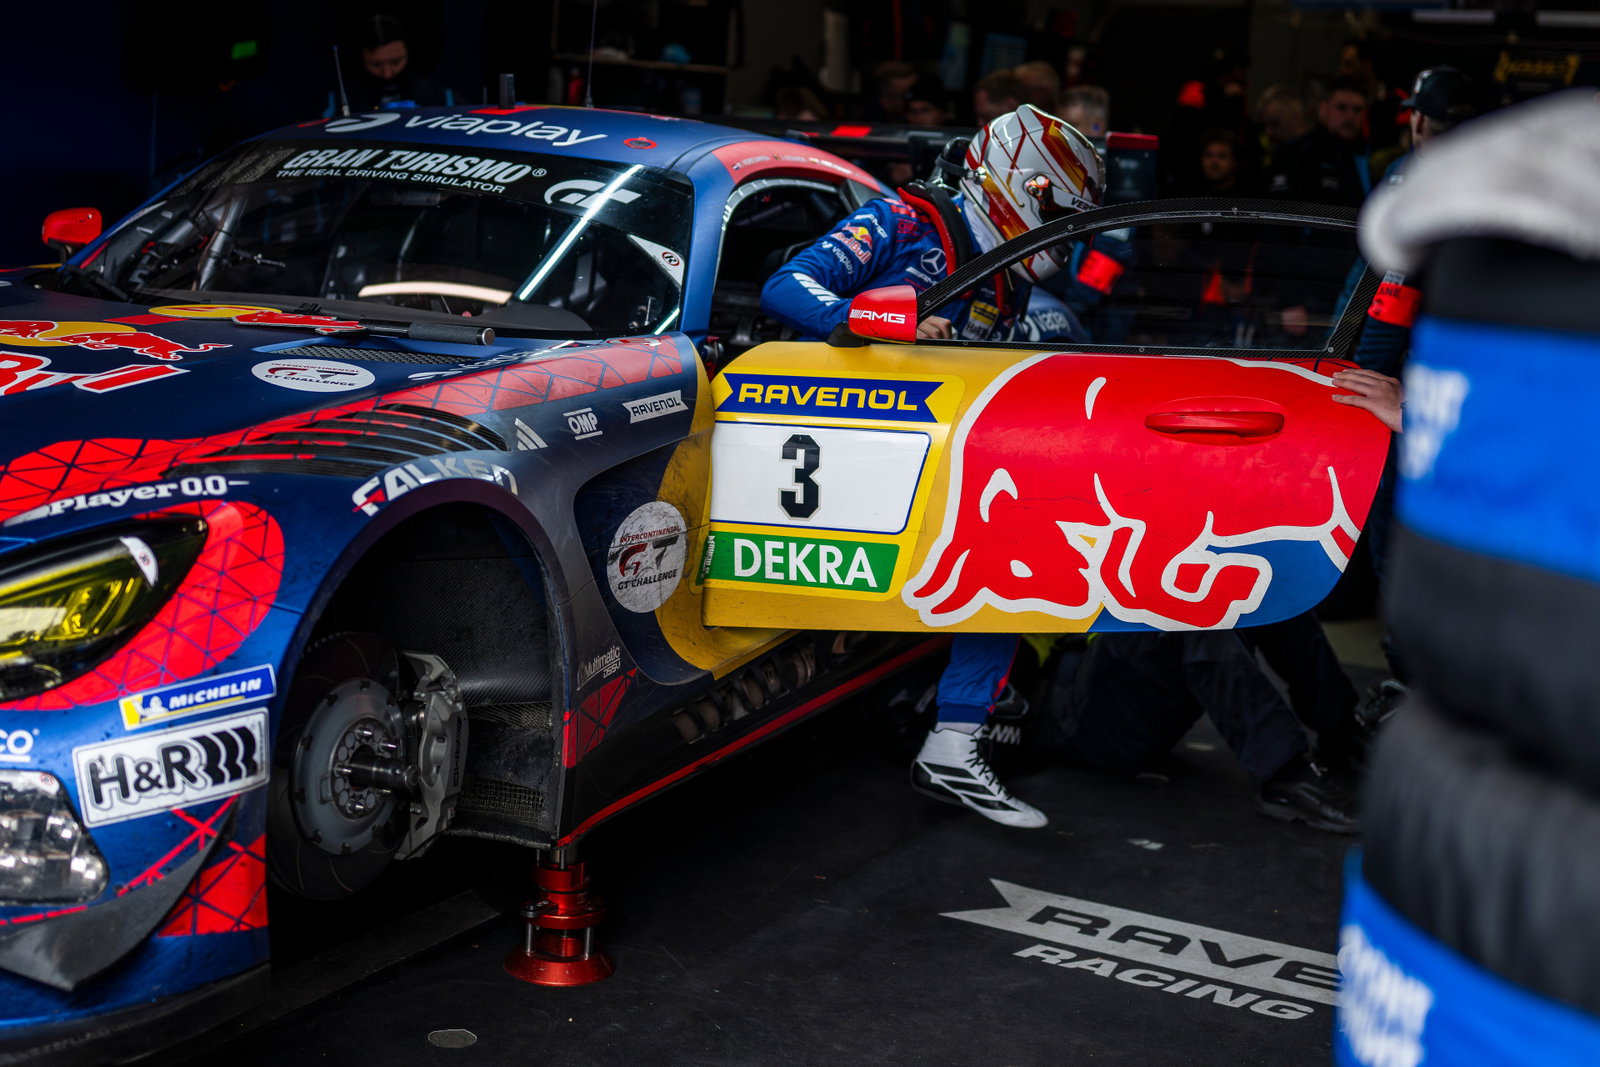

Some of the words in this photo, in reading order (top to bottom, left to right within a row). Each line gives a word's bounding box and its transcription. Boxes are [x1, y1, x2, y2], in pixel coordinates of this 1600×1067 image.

[405, 114, 608, 147] viaplay
[283, 149, 383, 170] GRAN
[276, 170, 304, 178] THE
[307, 168, 342, 177] REAL
[345, 168, 407, 180] DRIVING
[410, 173, 506, 194] SIMULATOR
[832, 245, 855, 275] viaplay
[858, 309, 906, 325] AMG
[283, 375, 357, 387] CHALLENGE
[630, 395, 682, 418] RAVENOL
[738, 383, 919, 412] RAVENOL
[568, 411, 599, 435] OMP
[352, 456, 519, 517] FALKEN
[777, 432, 822, 521] 3
[620, 525, 682, 543] INTERCONTINENTAL
[733, 537, 878, 588] DEKRA
[617, 579, 632, 591] GT
[631, 568, 678, 588] CHALLENGE
[168, 677, 262, 710] MICHELIN
[88, 744, 198, 805] H&R
[1012, 943, 1315, 1020] RACING
